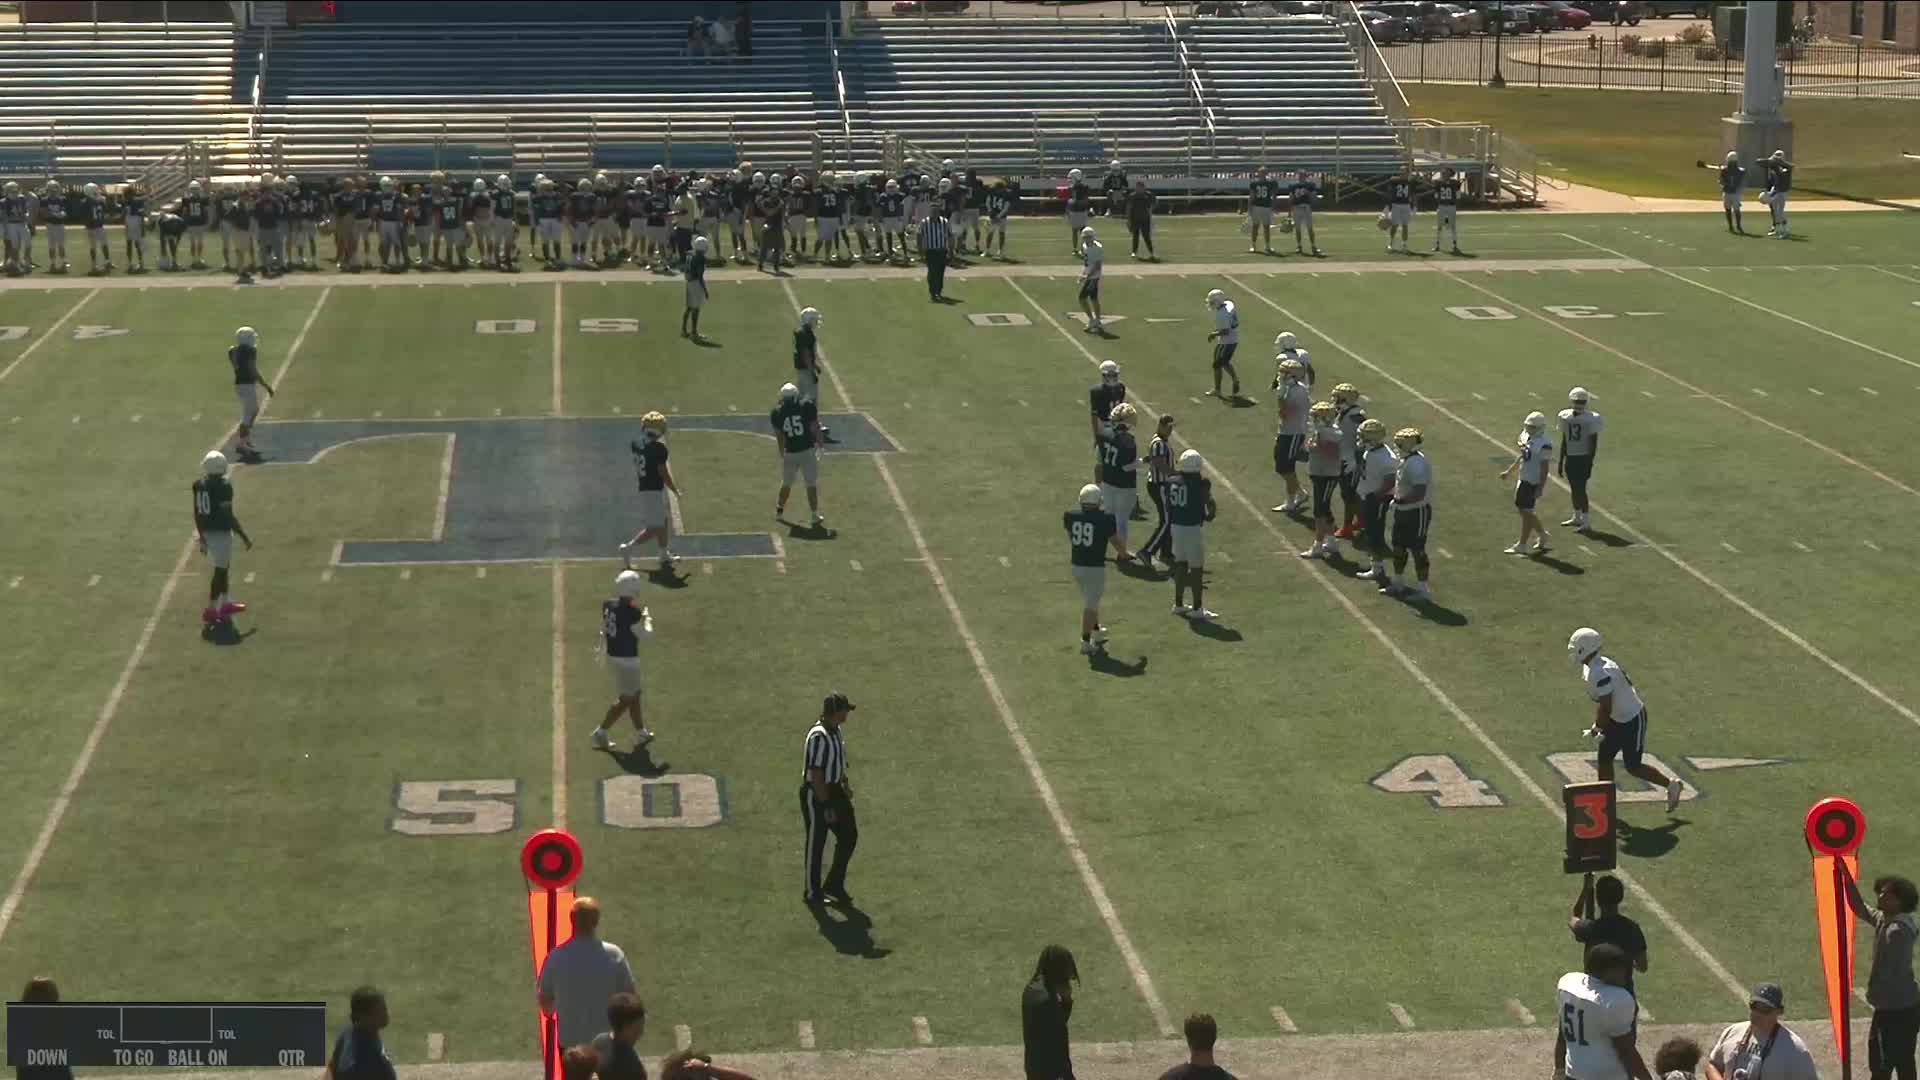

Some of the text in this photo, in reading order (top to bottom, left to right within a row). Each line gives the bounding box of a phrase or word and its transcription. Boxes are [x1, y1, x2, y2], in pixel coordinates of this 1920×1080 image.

[783, 415, 804, 438] 45
[1567, 423, 1582, 441] 13
[1103, 442, 1119, 466] 77
[1169, 484, 1188, 506] 50
[1071, 521, 1095, 546] 99
[390, 774, 724, 836] 50
[1573, 793, 1608, 839] 3
[1563, 1002, 1590, 1047] 51
